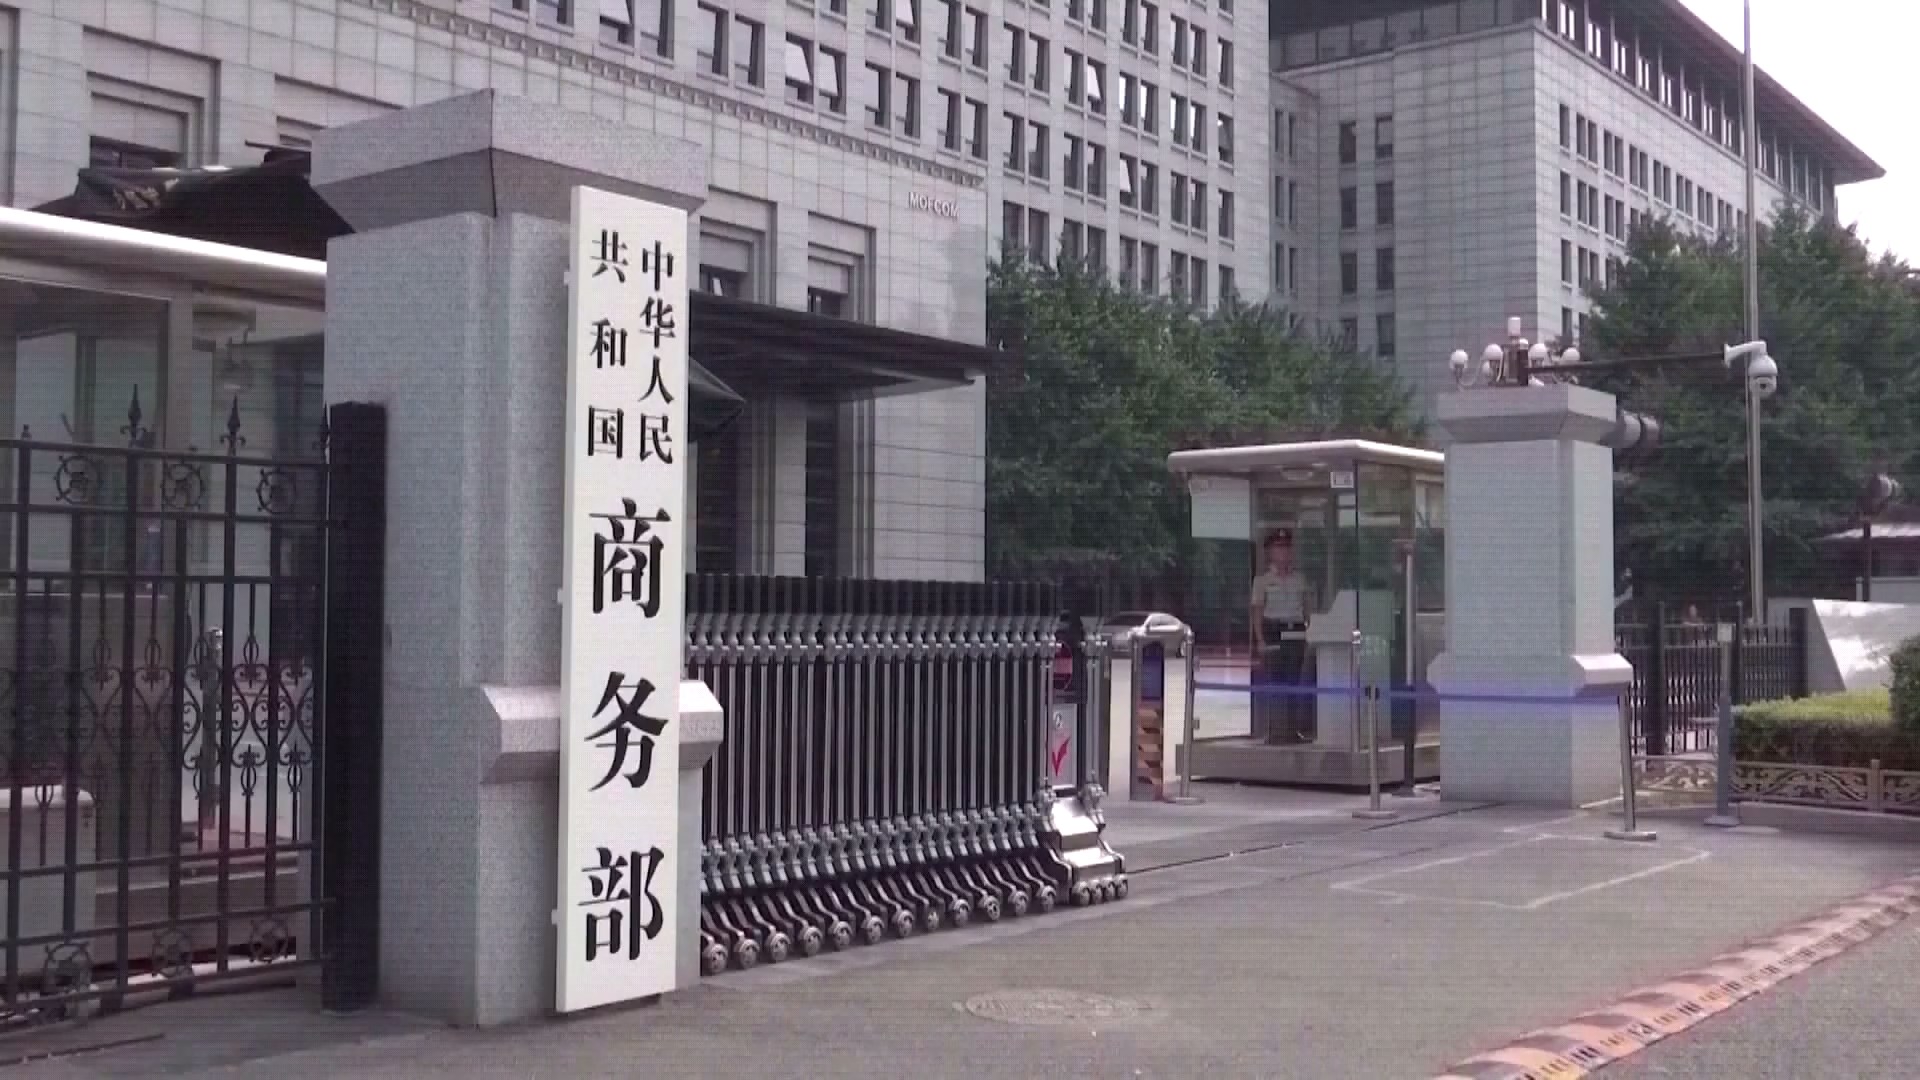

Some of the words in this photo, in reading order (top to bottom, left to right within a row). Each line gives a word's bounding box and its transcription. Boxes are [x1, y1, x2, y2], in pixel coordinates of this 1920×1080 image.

[908, 191, 960, 217] MOFCOM
[588, 229, 629, 460] 共和国
[638, 240, 676, 465] 中华人民
[578, 497, 672, 962] 商务部
